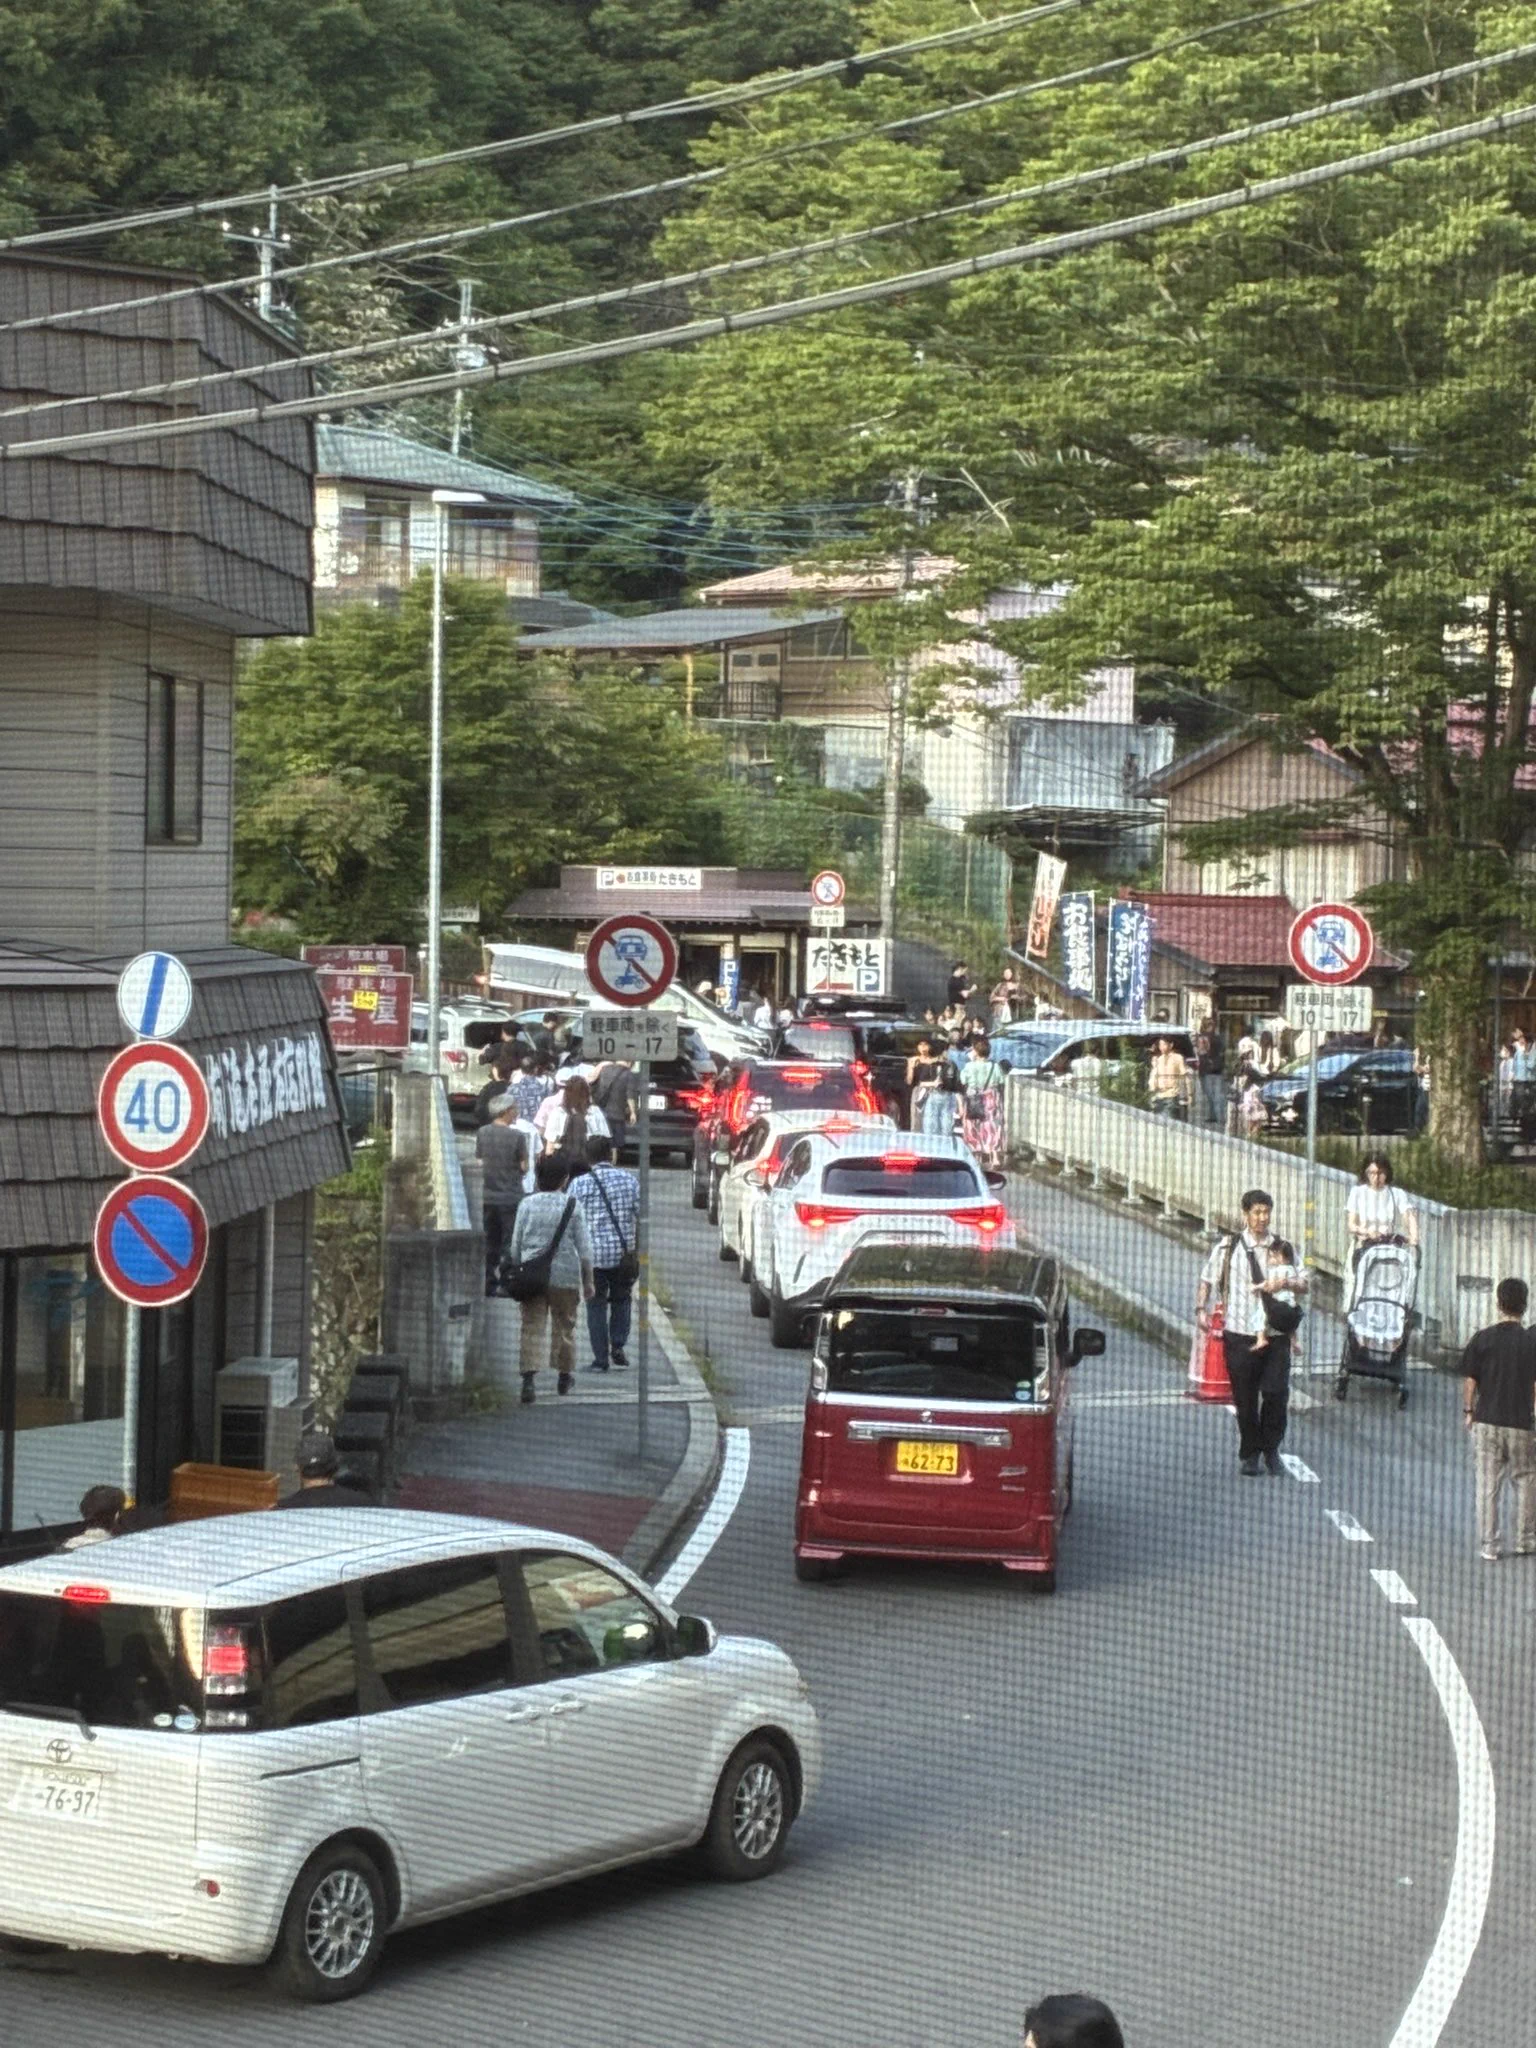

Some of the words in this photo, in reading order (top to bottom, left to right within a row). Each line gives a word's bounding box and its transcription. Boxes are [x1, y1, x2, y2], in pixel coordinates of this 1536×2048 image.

[659, 873, 697, 886] たきもと
[811, 941, 880, 972] たきもと
[1063, 902, 1092, 991] お食事処
[859, 970, 878, 992] P
[1301, 1010, 1315, 1026] 10
[1343, 1011, 1358, 1028] 17
[599, 1037, 616, 1055] 10
[646, 1037, 663, 1055] 17
[123, 1080, 181, 1134] 40
